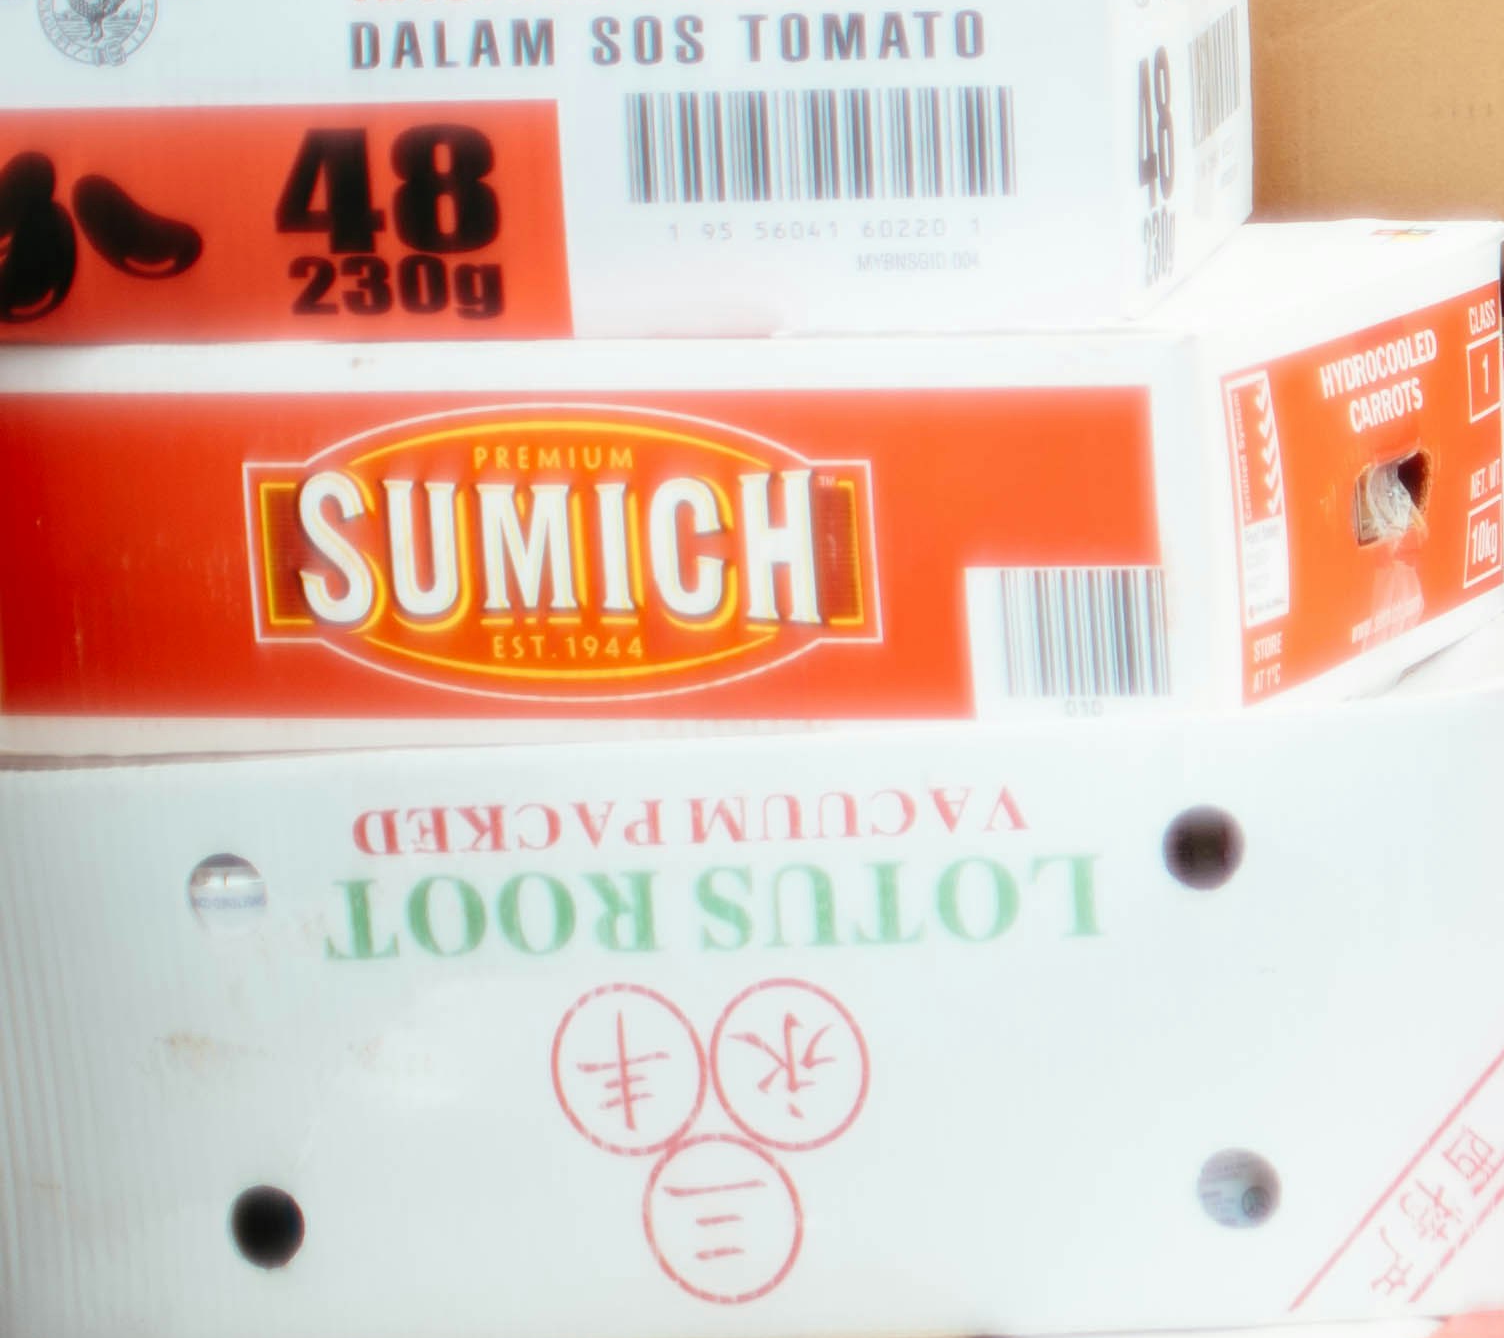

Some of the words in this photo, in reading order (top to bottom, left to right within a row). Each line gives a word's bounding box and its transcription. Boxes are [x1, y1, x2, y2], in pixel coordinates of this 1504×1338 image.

[350, 16, 557, 71] DALAM
[590, 14, 706, 67] SOS
[737, 8, 985, 63] TOMATO
[274, 122, 503, 256] 48
[288, 254, 506, 321] 230g
[1319, 328, 1438, 398] HYDROCOOLED
[1349, 377, 1423, 434] CARROTS
[472, 445, 635, 470] PREMIUM
[295, 466, 825, 630] SUMICH
[349, 797, 666, 860] PACKED
[684, 782, 1031, 847] VACUUM
[318, 864, 664, 966] ROOT
[687, 849, 1103, 955] LOTUS
